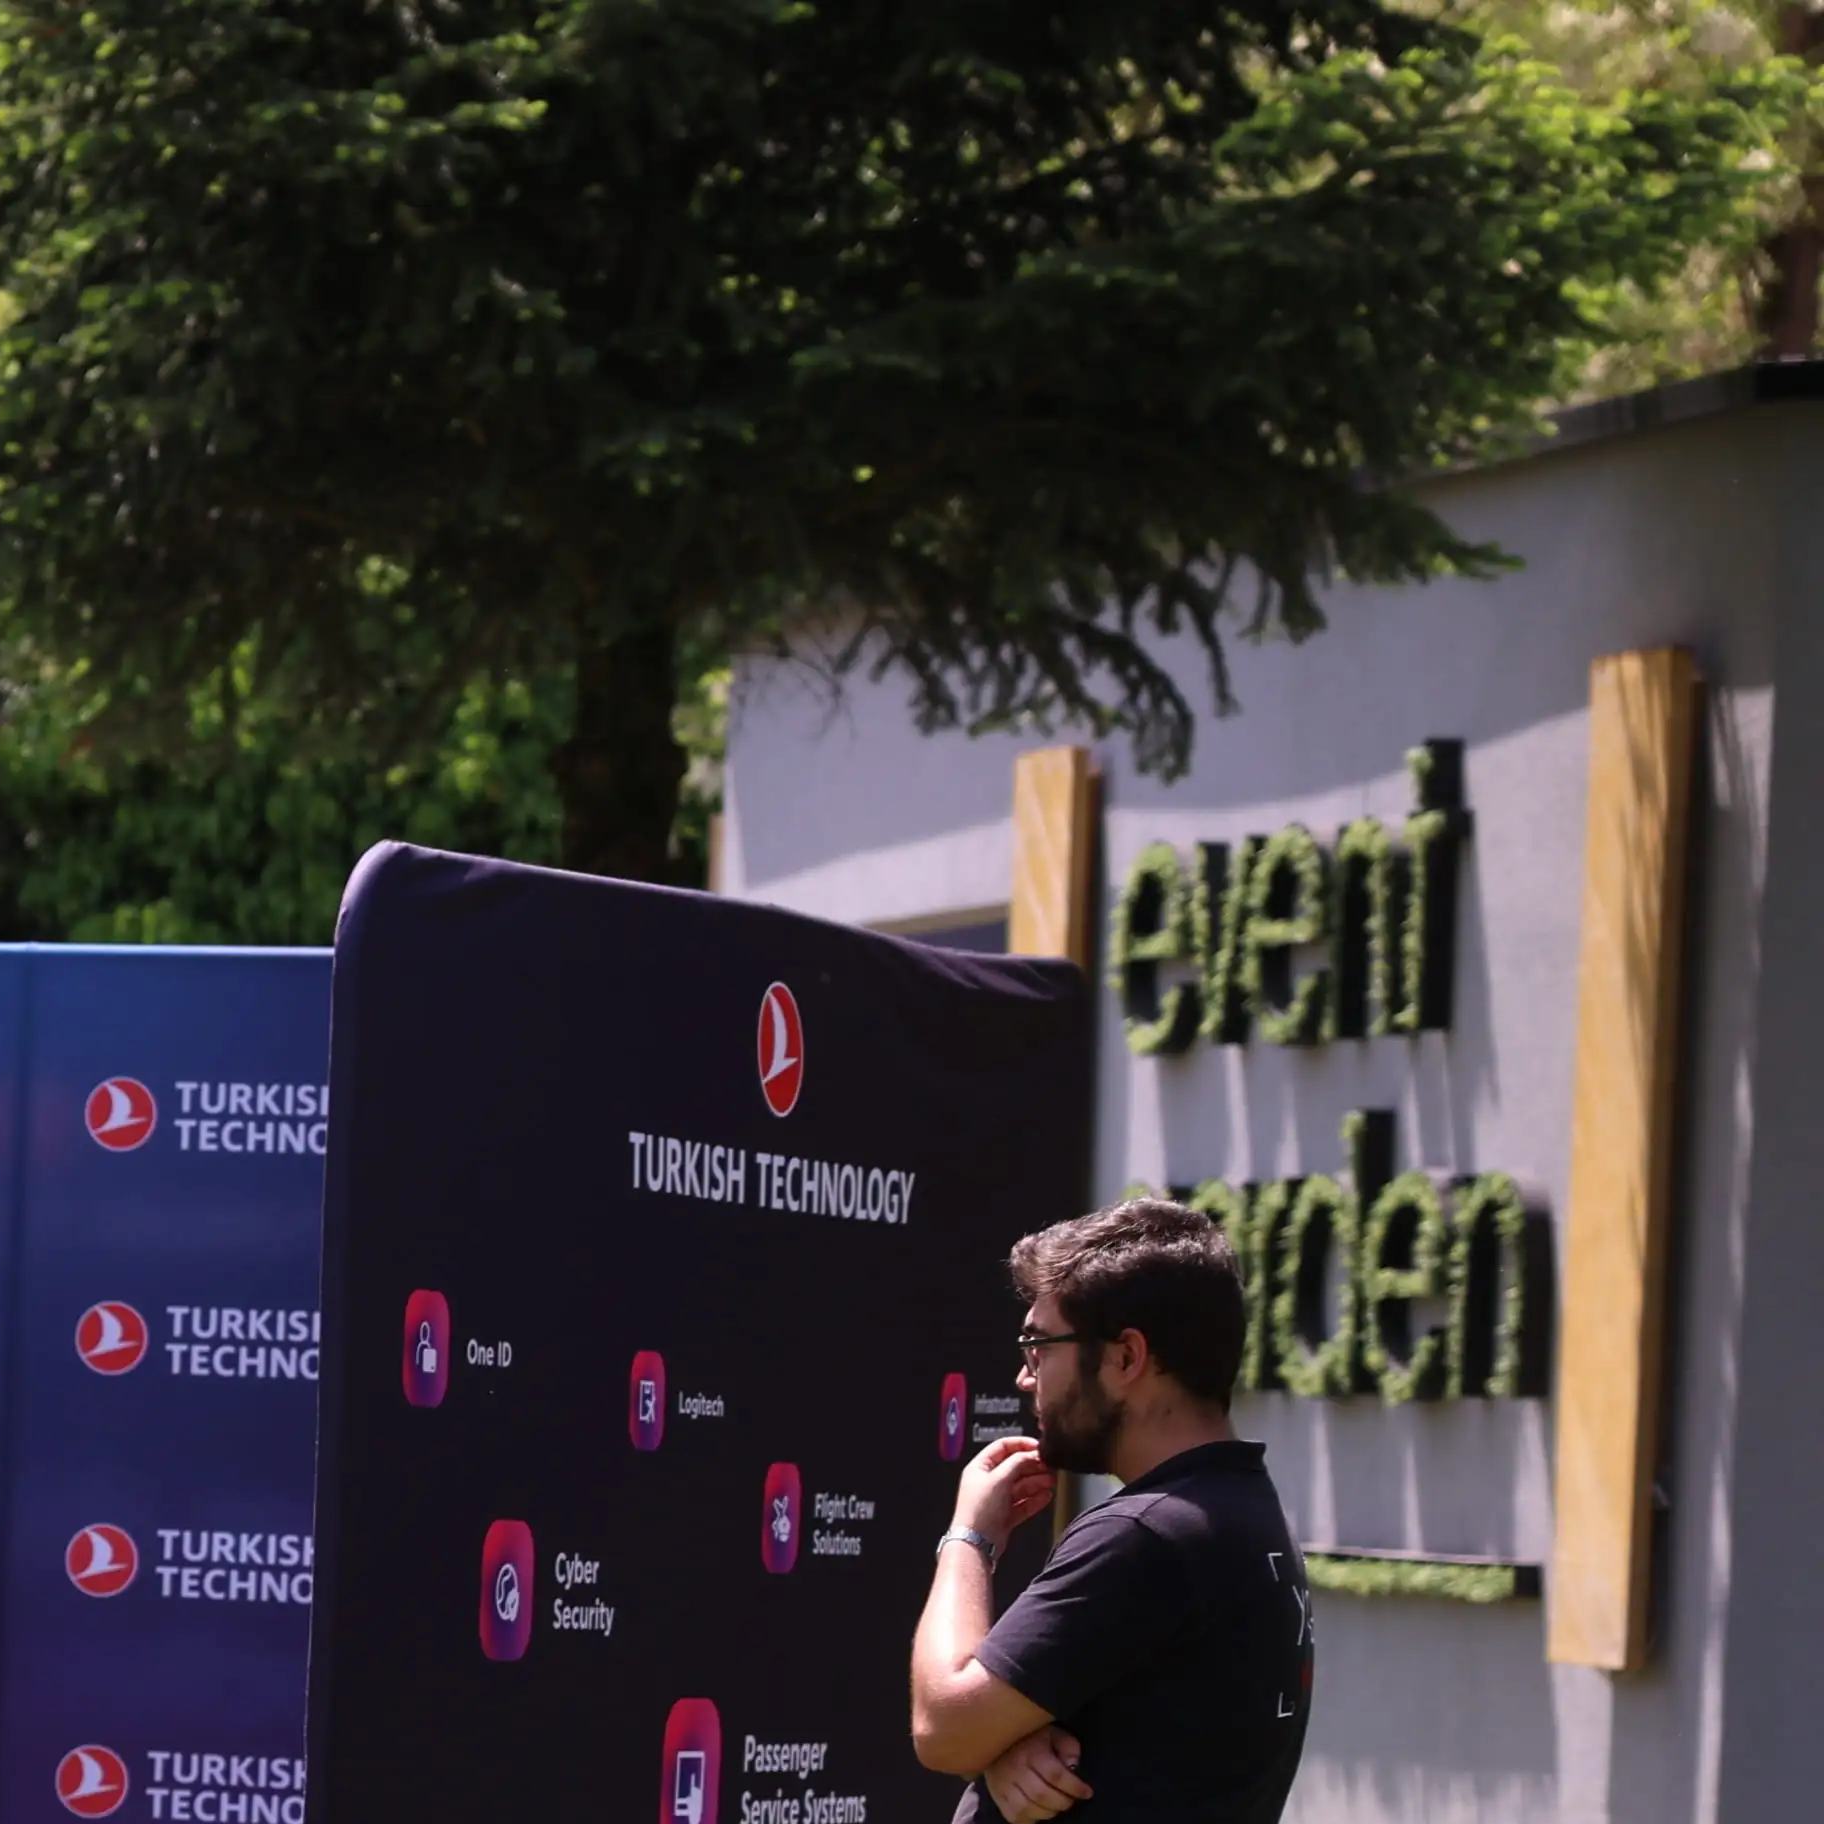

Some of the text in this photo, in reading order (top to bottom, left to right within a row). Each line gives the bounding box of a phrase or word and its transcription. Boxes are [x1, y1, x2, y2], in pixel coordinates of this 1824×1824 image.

[1109, 737, 1470, 1056] event
[173, 1119, 327, 1155] TECHNO
[629, 1131, 915, 1225] TURKISH TECHNOLOGY
[165, 1344, 319, 1380] TECHNO
[467, 1338, 512, 1368] One ID
[678, 1391, 724, 1419] Logitech
[815, 1492, 875, 1524] Flight Crew
[813, 1529, 861, 1556] Solutions
[155, 1566, 313, 1604] TECHNO
[555, 1552, 600, 1590] Cyber
[552, 1597, 615, 1637] Security
[743, 1734, 828, 1780] Passenger
